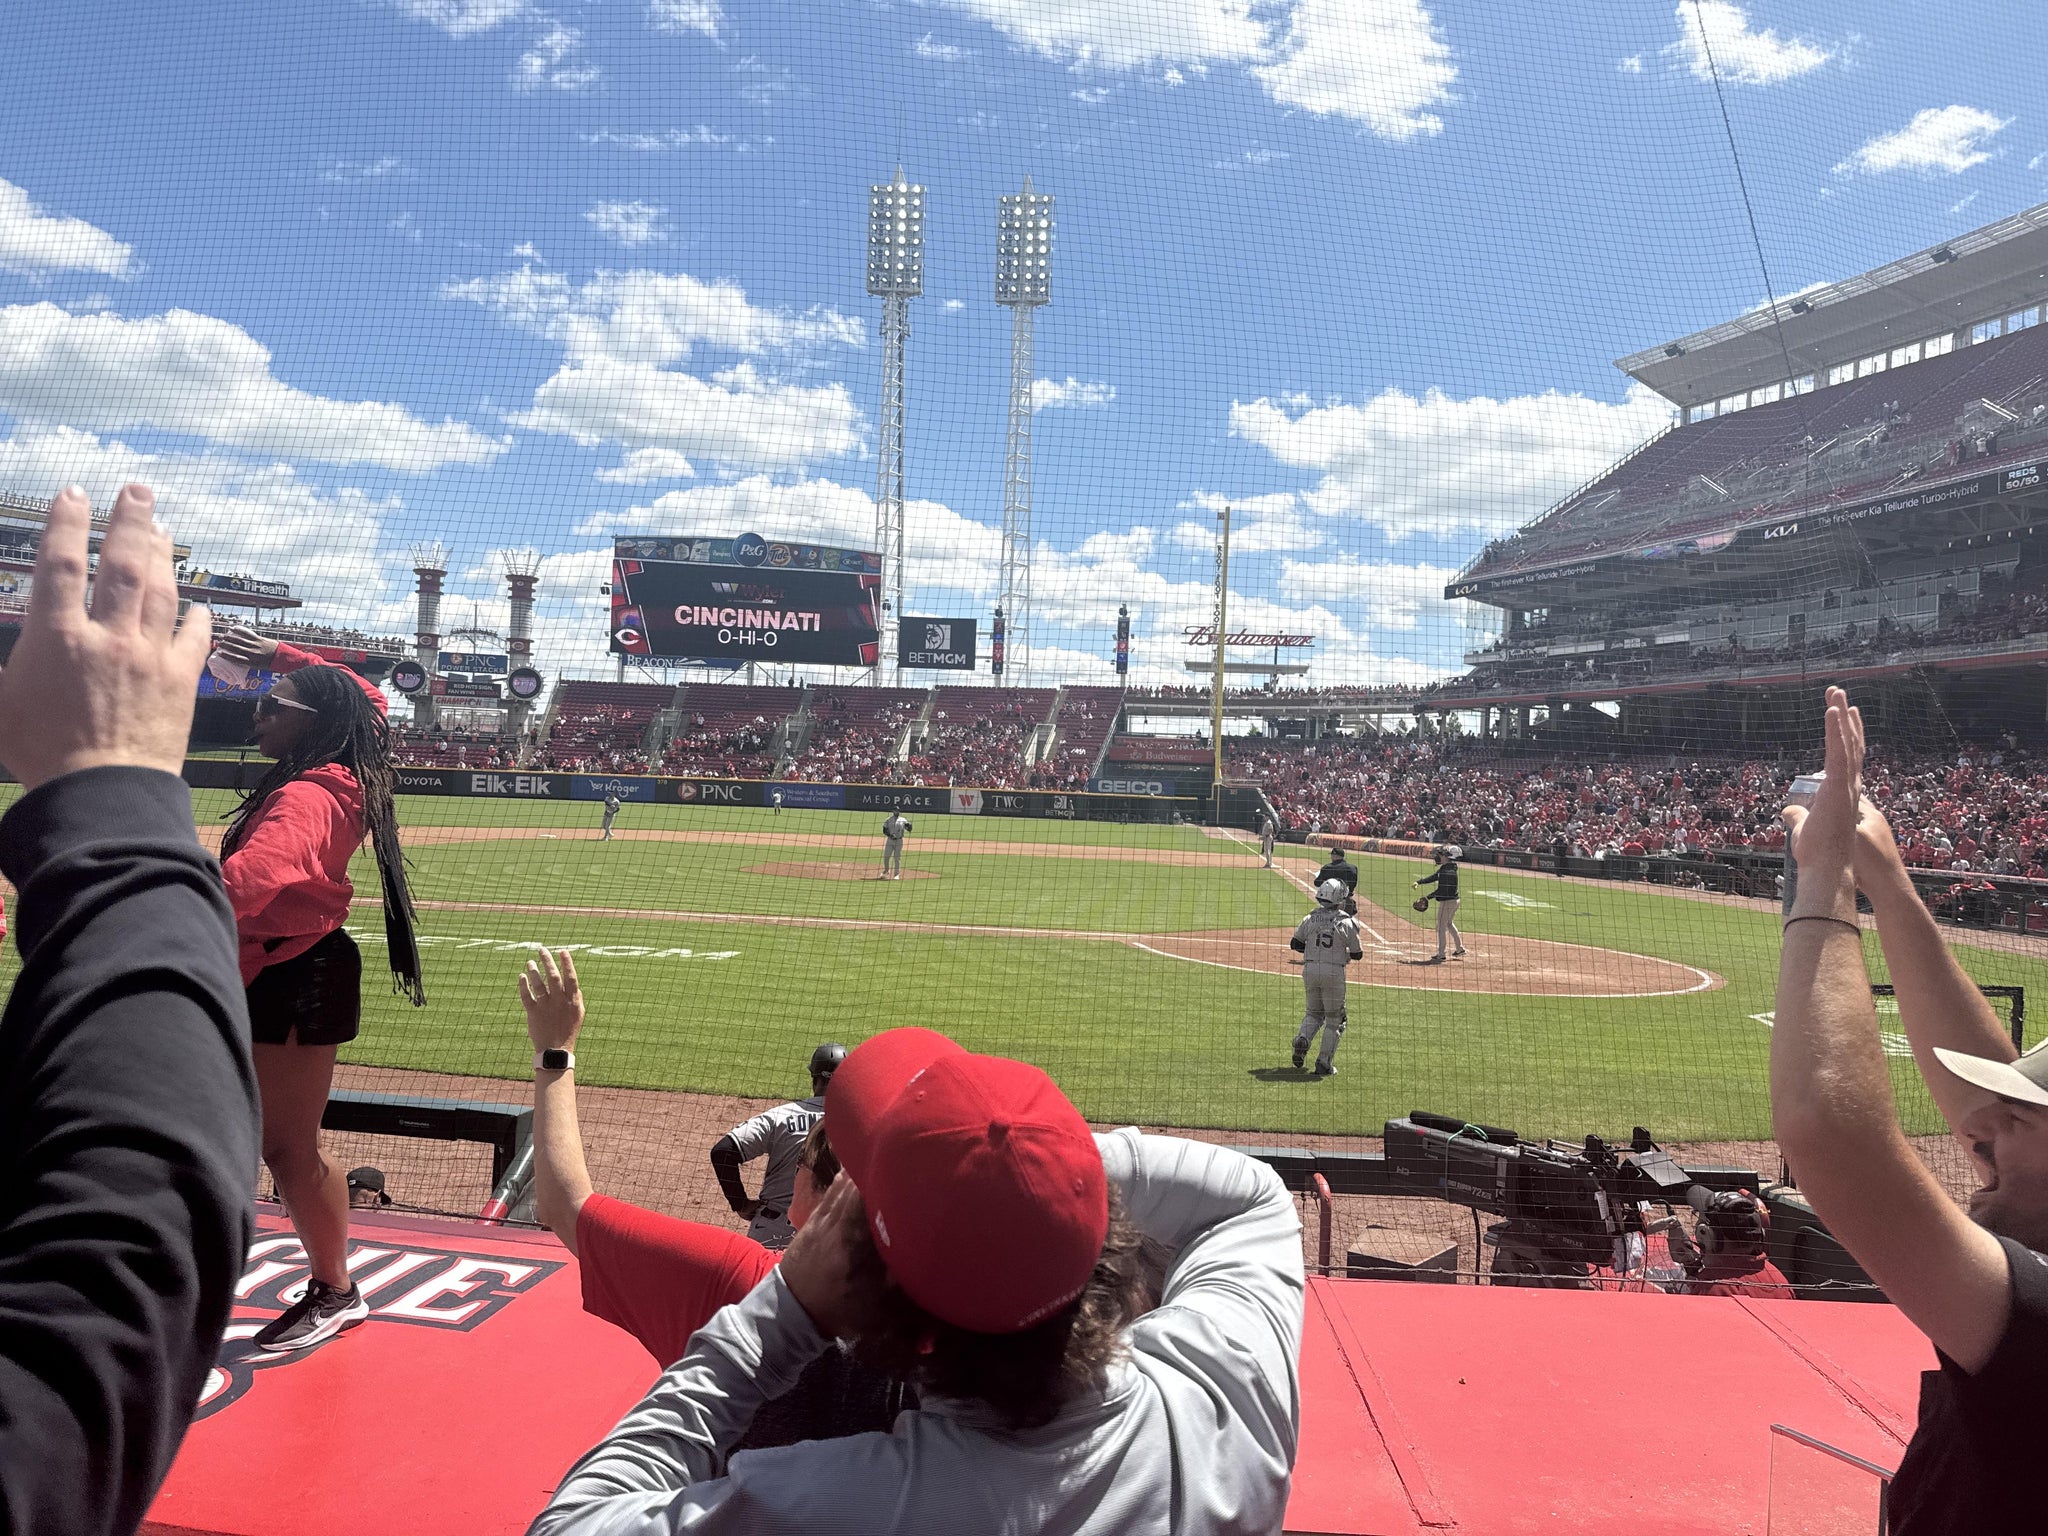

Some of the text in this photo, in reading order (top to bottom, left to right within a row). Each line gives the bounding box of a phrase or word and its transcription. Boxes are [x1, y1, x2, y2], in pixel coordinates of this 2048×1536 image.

[2008, 466, 2037, 479] REDS
[2006, 475, 2039, 489] 50/50
[1818, 516, 1832, 527] The
[1869, 505, 1882, 516] Kia
[1884, 497, 1919, 513] Telluride
[1920, 483, 1979, 506] Turbo-Hybrid
[1763, 522, 1798, 540] KIA
[740, 543, 764, 557] P&G
[767, 549, 787, 561] Tide
[241, 580, 289, 596] TriHealth
[1455, 583, 1478, 596] KIA
[674, 605, 821, 632] CINCINNATI
[717, 628, 778, 647] O-HI-O
[463, 655, 497, 667] PNC
[627, 654, 674, 668] BEACON
[908, 651, 967, 665] BETMGM
[441, 664, 505, 674] POWER STACKS
[1145, 751, 1192, 761] Budweiser
[399, 776, 442, 786] TOYOTA
[1098, 779, 1163, 794] GEICO
[605, 779, 640, 798] Kroger
[701, 784, 743, 801] PNC
[862, 793, 932, 806] MEDPACE
[992, 795, 1025, 809] TWC
[1505, 856, 1521, 865] TOYOTA
[1315, 933, 1334, 949] 15
[786, 1111, 825, 1133] GON
